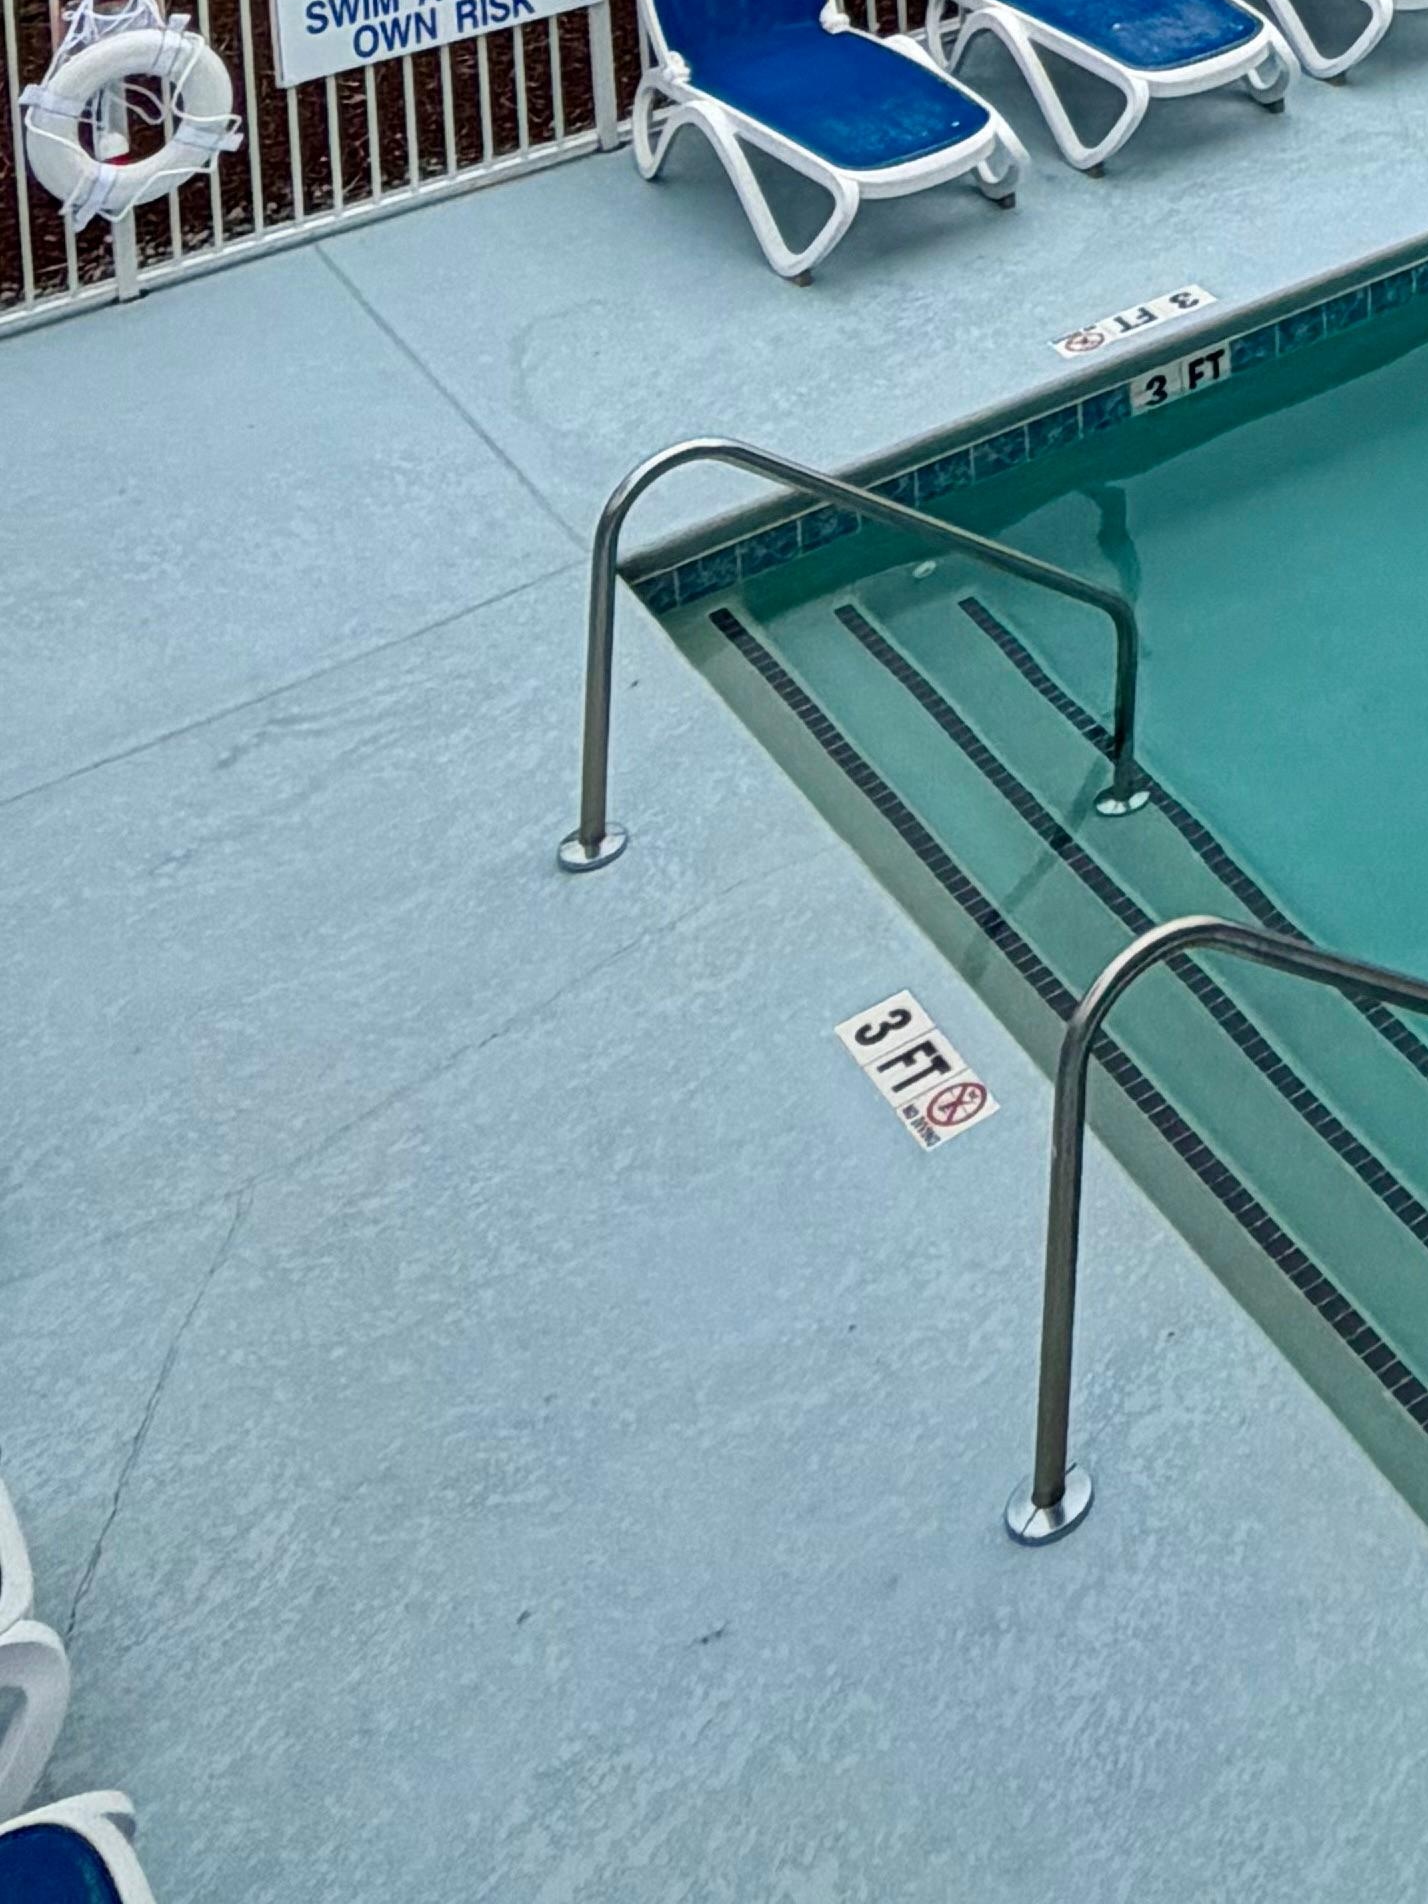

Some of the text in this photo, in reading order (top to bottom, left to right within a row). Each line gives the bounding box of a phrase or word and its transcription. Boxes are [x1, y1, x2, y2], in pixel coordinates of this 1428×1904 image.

[353, 6, 438, 59] OWN
[1113, 306, 1159, 334] FT
[1168, 291, 1200, 309] 3
[1143, 348, 1225, 406] 3 FT
[854, 1008, 952, 1094] 3 FT
